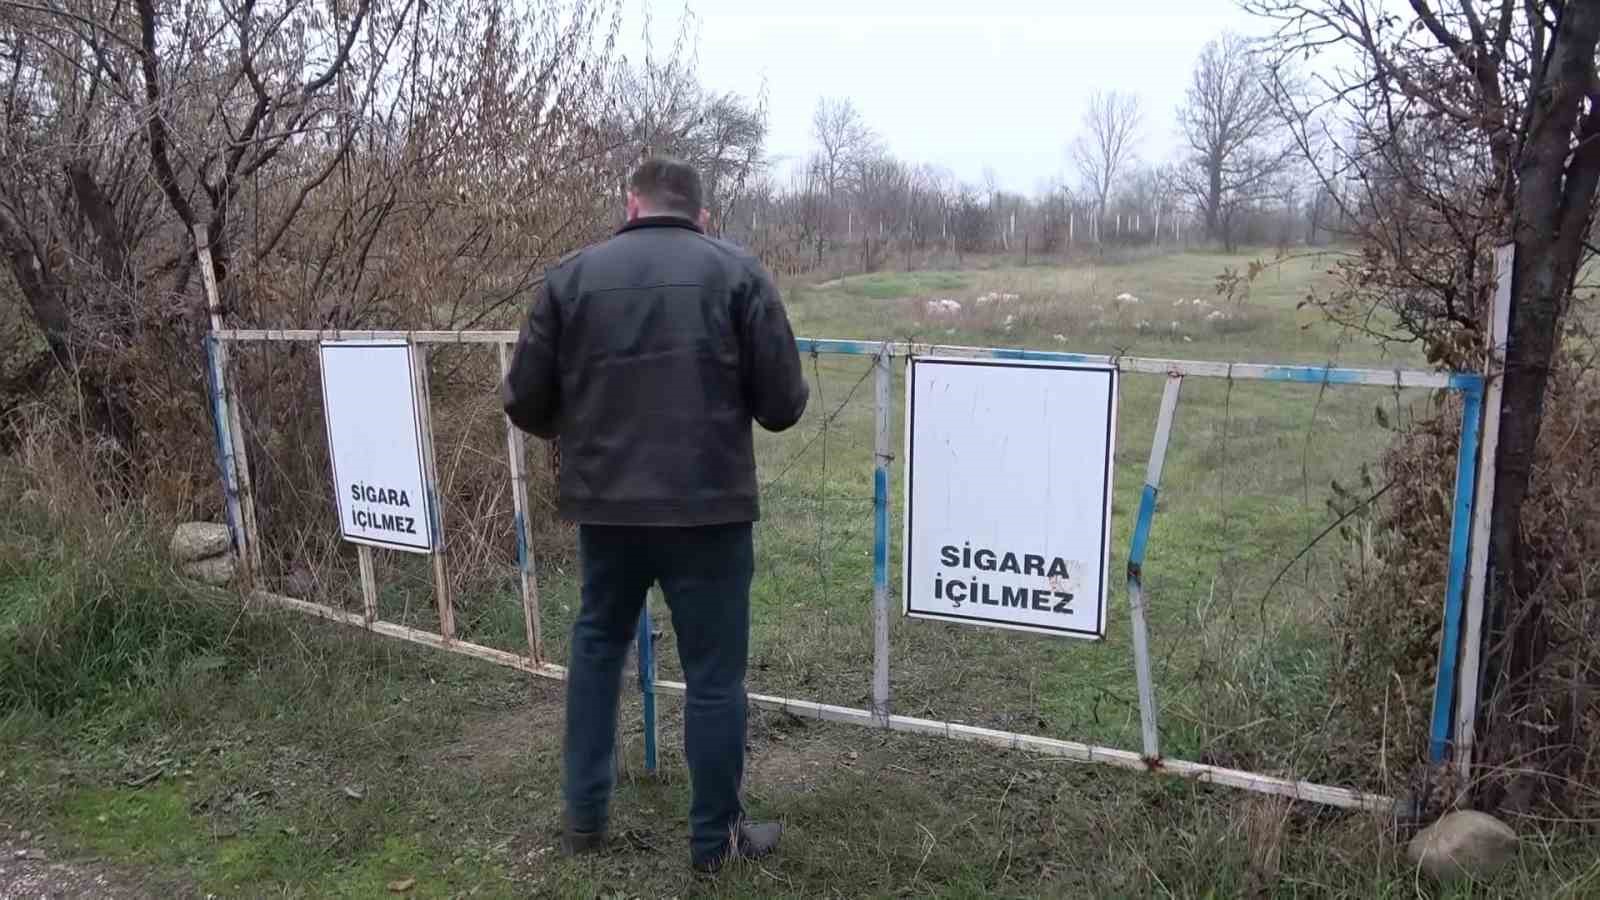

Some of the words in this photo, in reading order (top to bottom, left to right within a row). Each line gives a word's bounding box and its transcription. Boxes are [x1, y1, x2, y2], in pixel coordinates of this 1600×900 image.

[351, 481, 410, 508] SİGARA
[351, 507, 417, 535] İÇİLMEZ
[940, 541, 1070, 580] SİGARA
[934, 572, 1074, 615] İÇİLMEZ
